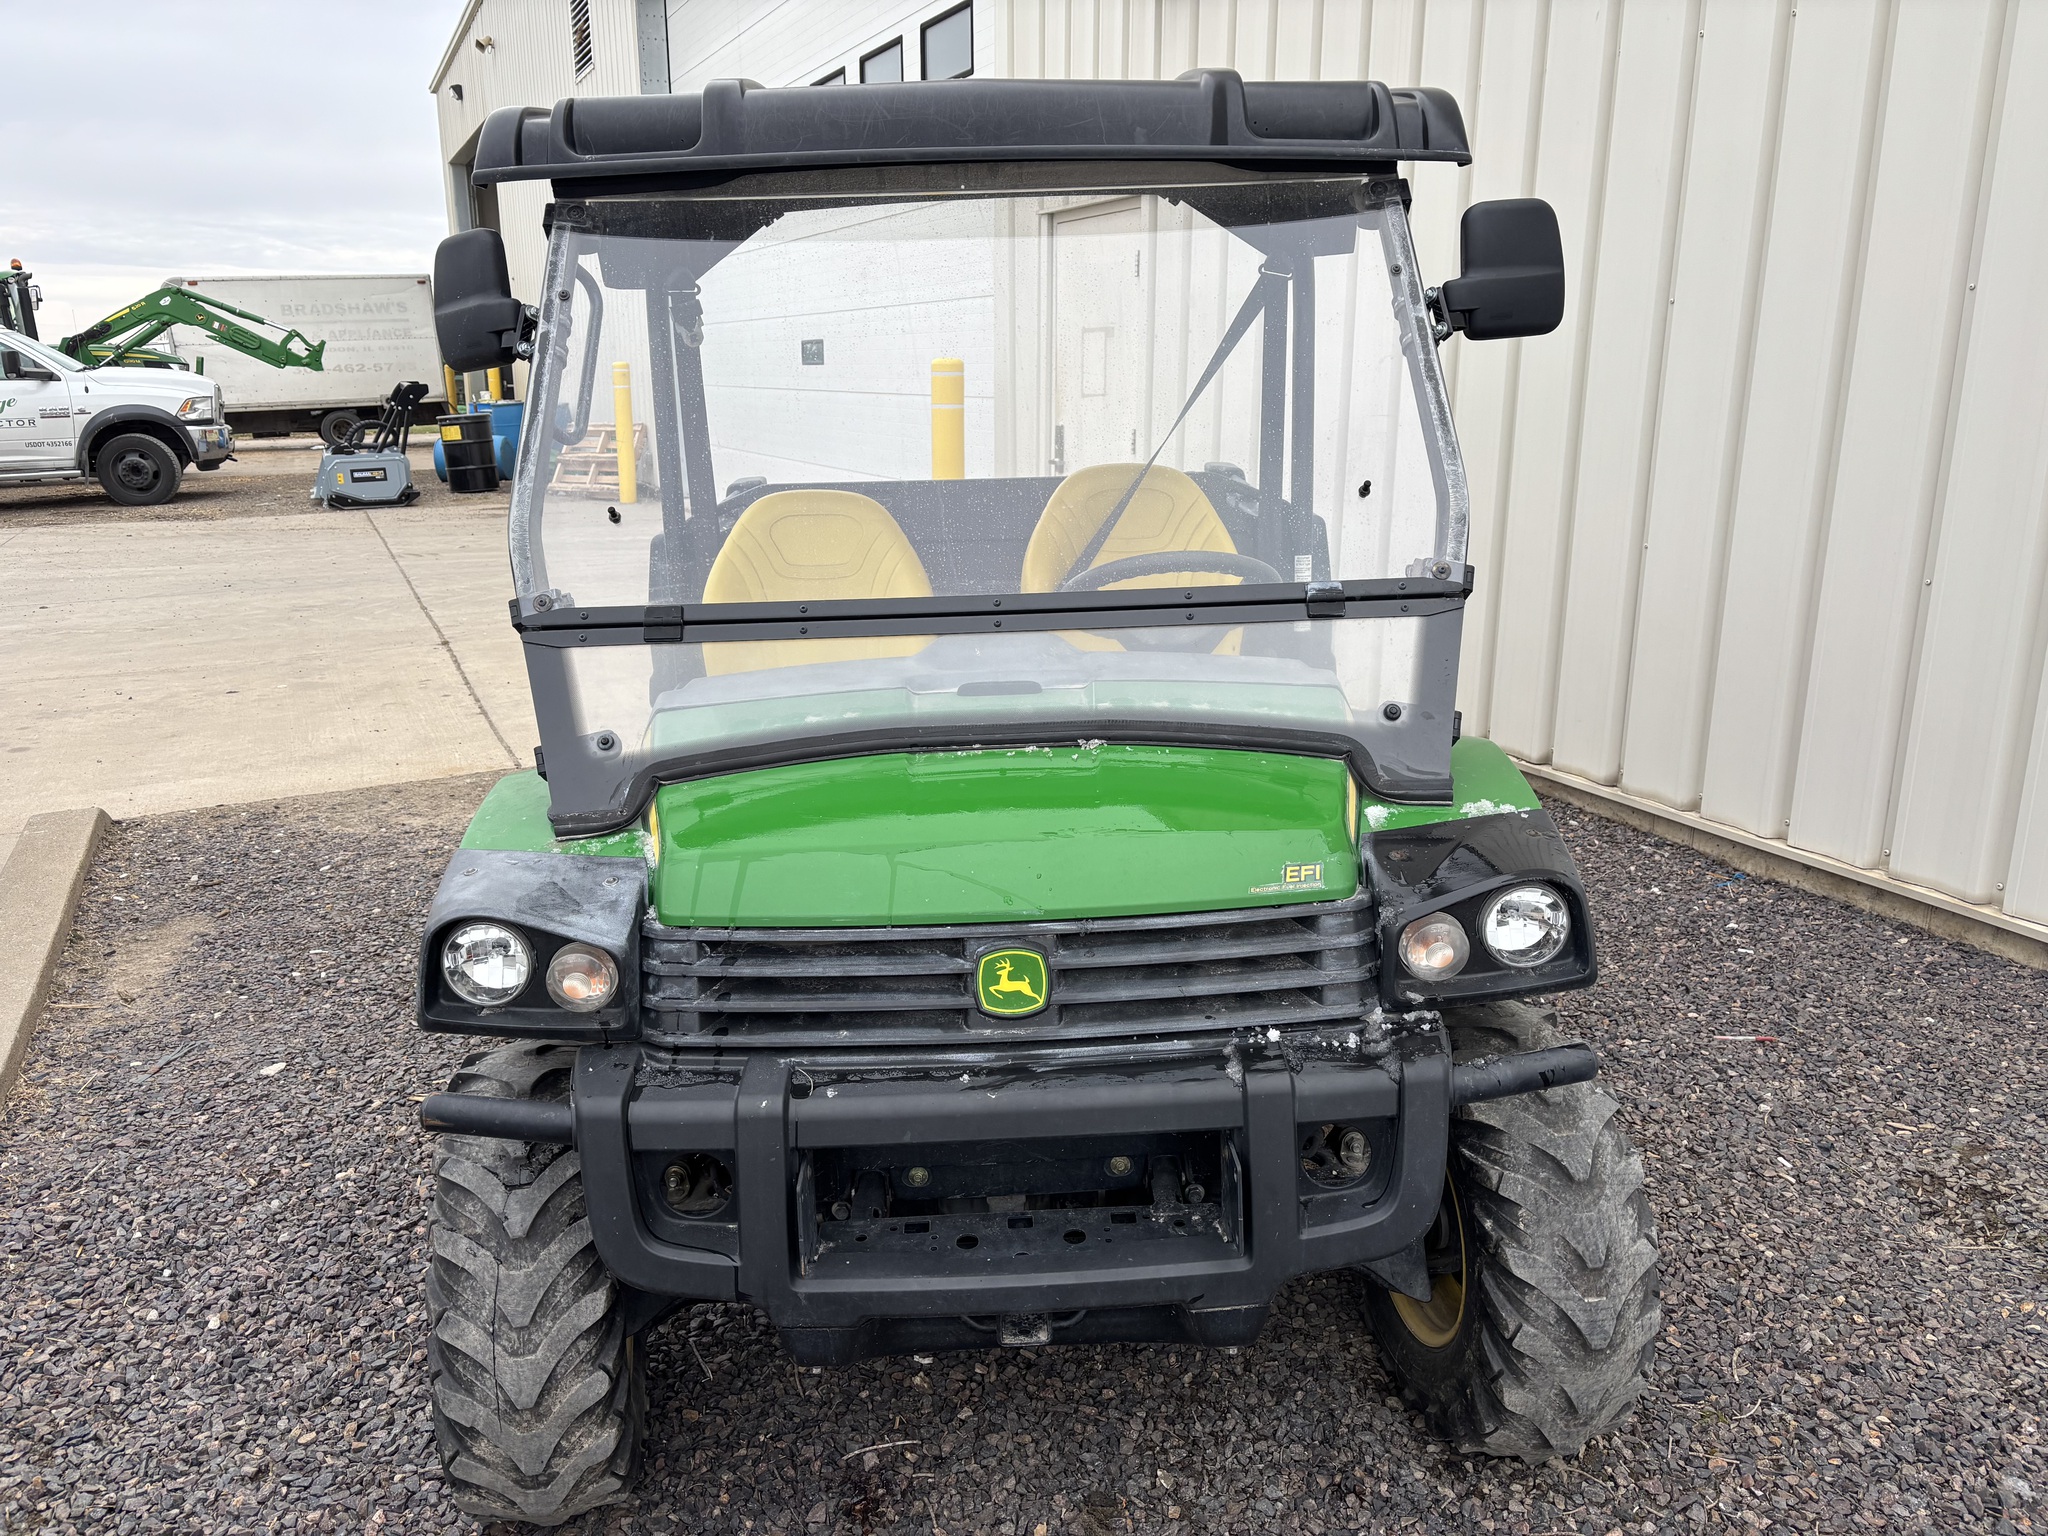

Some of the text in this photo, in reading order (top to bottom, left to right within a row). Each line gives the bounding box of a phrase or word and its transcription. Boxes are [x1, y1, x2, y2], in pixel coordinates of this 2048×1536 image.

[280, 301, 408, 317] BRADSHAW'S
[328, 327, 412, 340] APPLIANCE
[46, 440, 73, 448] 4352166
[1285, 864, 1321, 883] EFI
